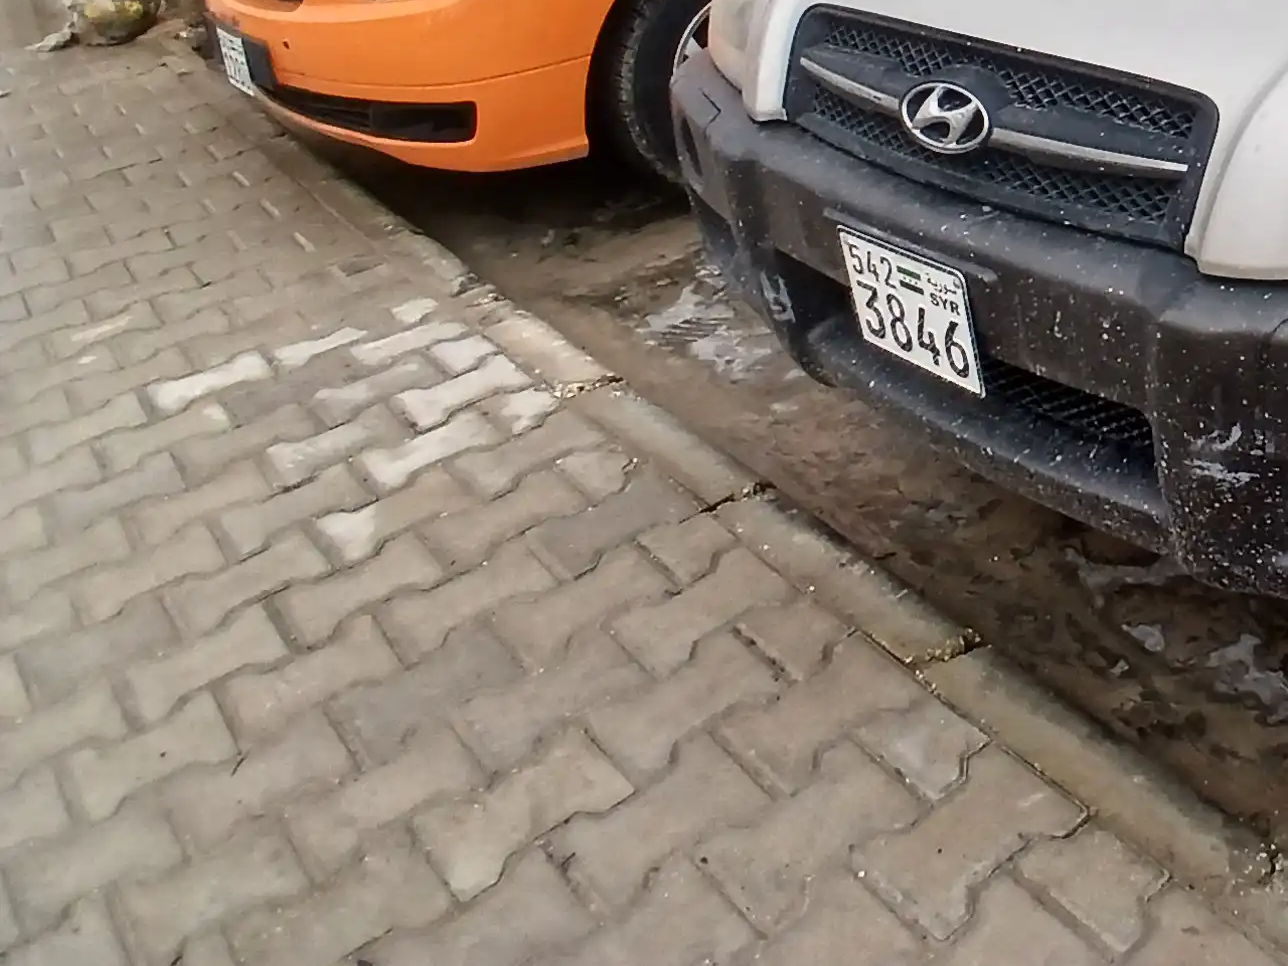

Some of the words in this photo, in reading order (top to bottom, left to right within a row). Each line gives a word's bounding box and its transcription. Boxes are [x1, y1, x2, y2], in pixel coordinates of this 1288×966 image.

[847, 240, 897, 290] 542
[856, 279, 970, 379] 3846
[929, 292, 961, 316] SYR
